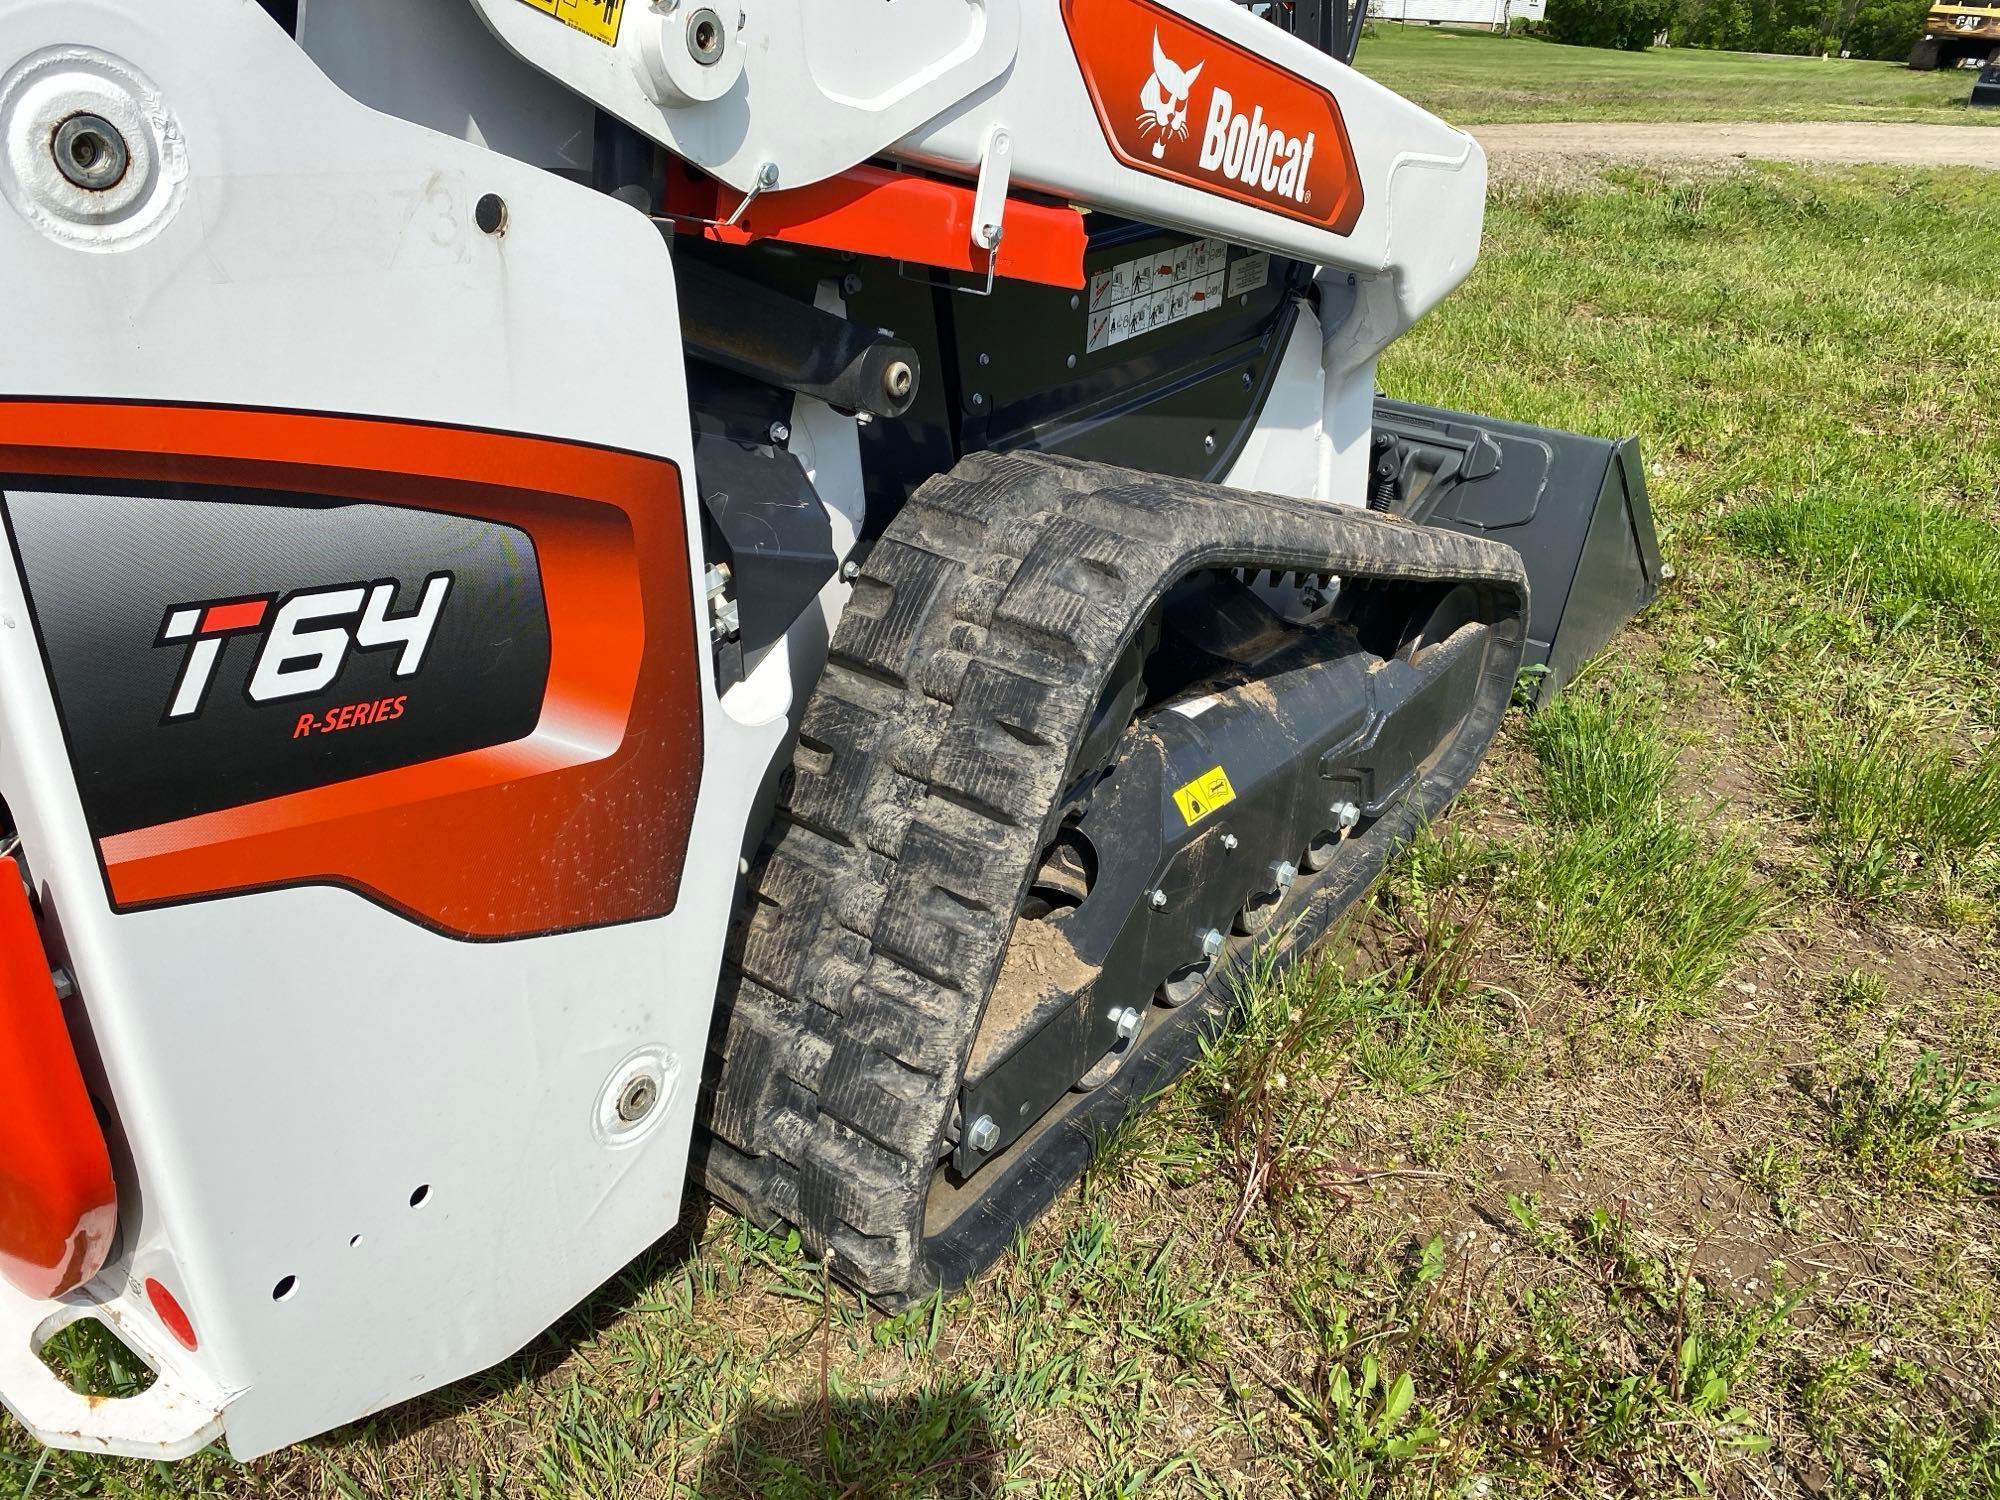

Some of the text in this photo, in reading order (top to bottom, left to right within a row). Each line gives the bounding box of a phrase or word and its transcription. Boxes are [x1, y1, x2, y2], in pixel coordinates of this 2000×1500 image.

[1956, 15, 1981, 26] CAT
[164, 577, 450, 717] T64
[292, 695, 408, 739] R-SERIES
